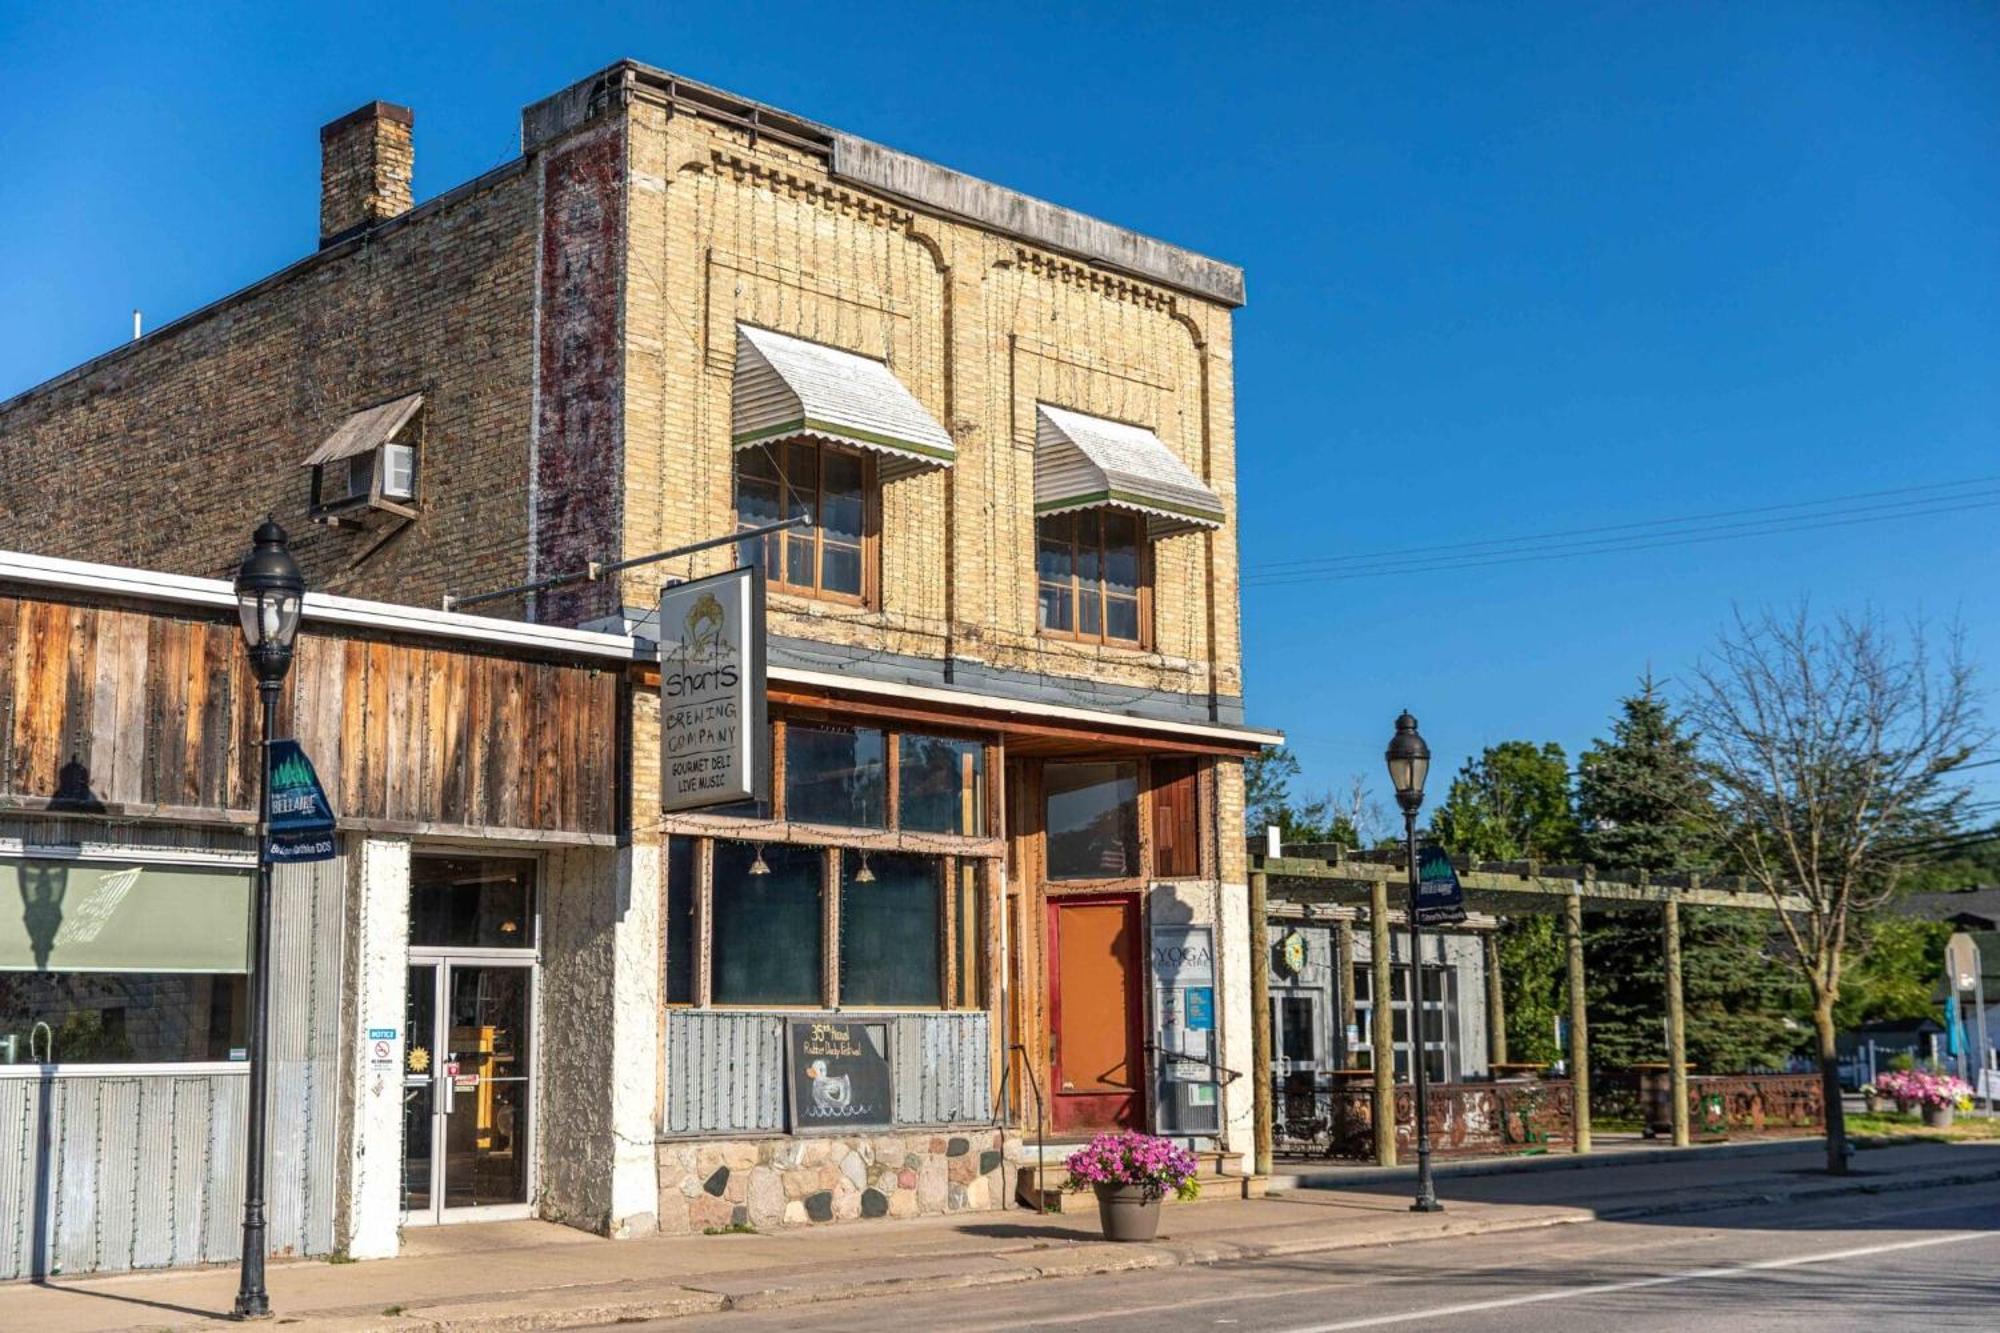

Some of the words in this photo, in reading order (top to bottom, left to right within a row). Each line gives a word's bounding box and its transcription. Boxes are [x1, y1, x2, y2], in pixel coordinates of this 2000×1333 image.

[667, 703, 737, 730] BREWING
[668, 726, 736, 753] COMPANY
[672, 758, 710, 777] GOURMET
[711, 755, 731, 770] DELI
[678, 777, 697, 793] LIVE
[698, 773, 725, 790] MUSIC
[272, 795, 316, 814] BELLAIRE
[1155, 946, 1210, 961] YOGA
[371, 1030, 394, 1038] NOTICE
